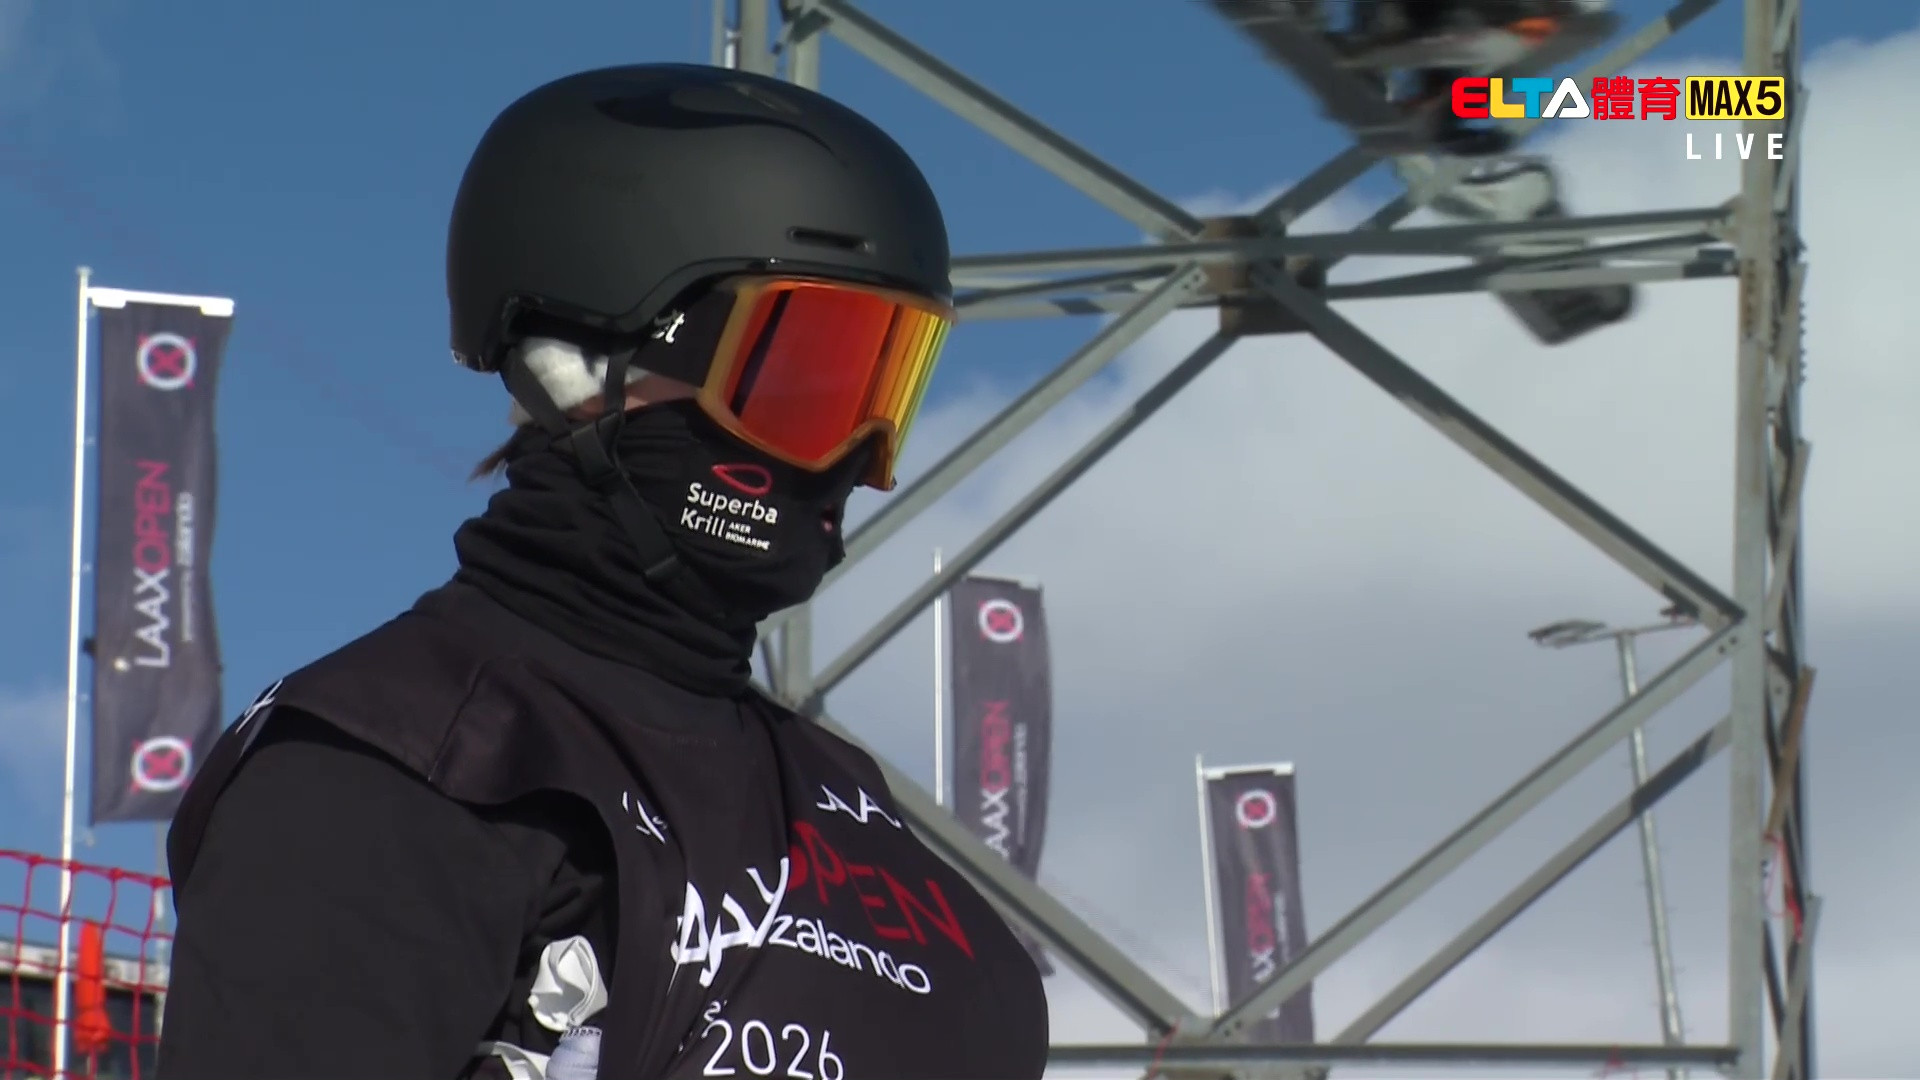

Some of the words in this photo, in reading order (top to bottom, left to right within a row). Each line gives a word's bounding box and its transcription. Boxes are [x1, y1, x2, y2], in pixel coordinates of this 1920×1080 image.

[686, 481, 779, 525] Superba
[680, 507, 726, 538] Krill
[728, 521, 752, 534] AKER
[701, 1018, 845, 1080] 2026
